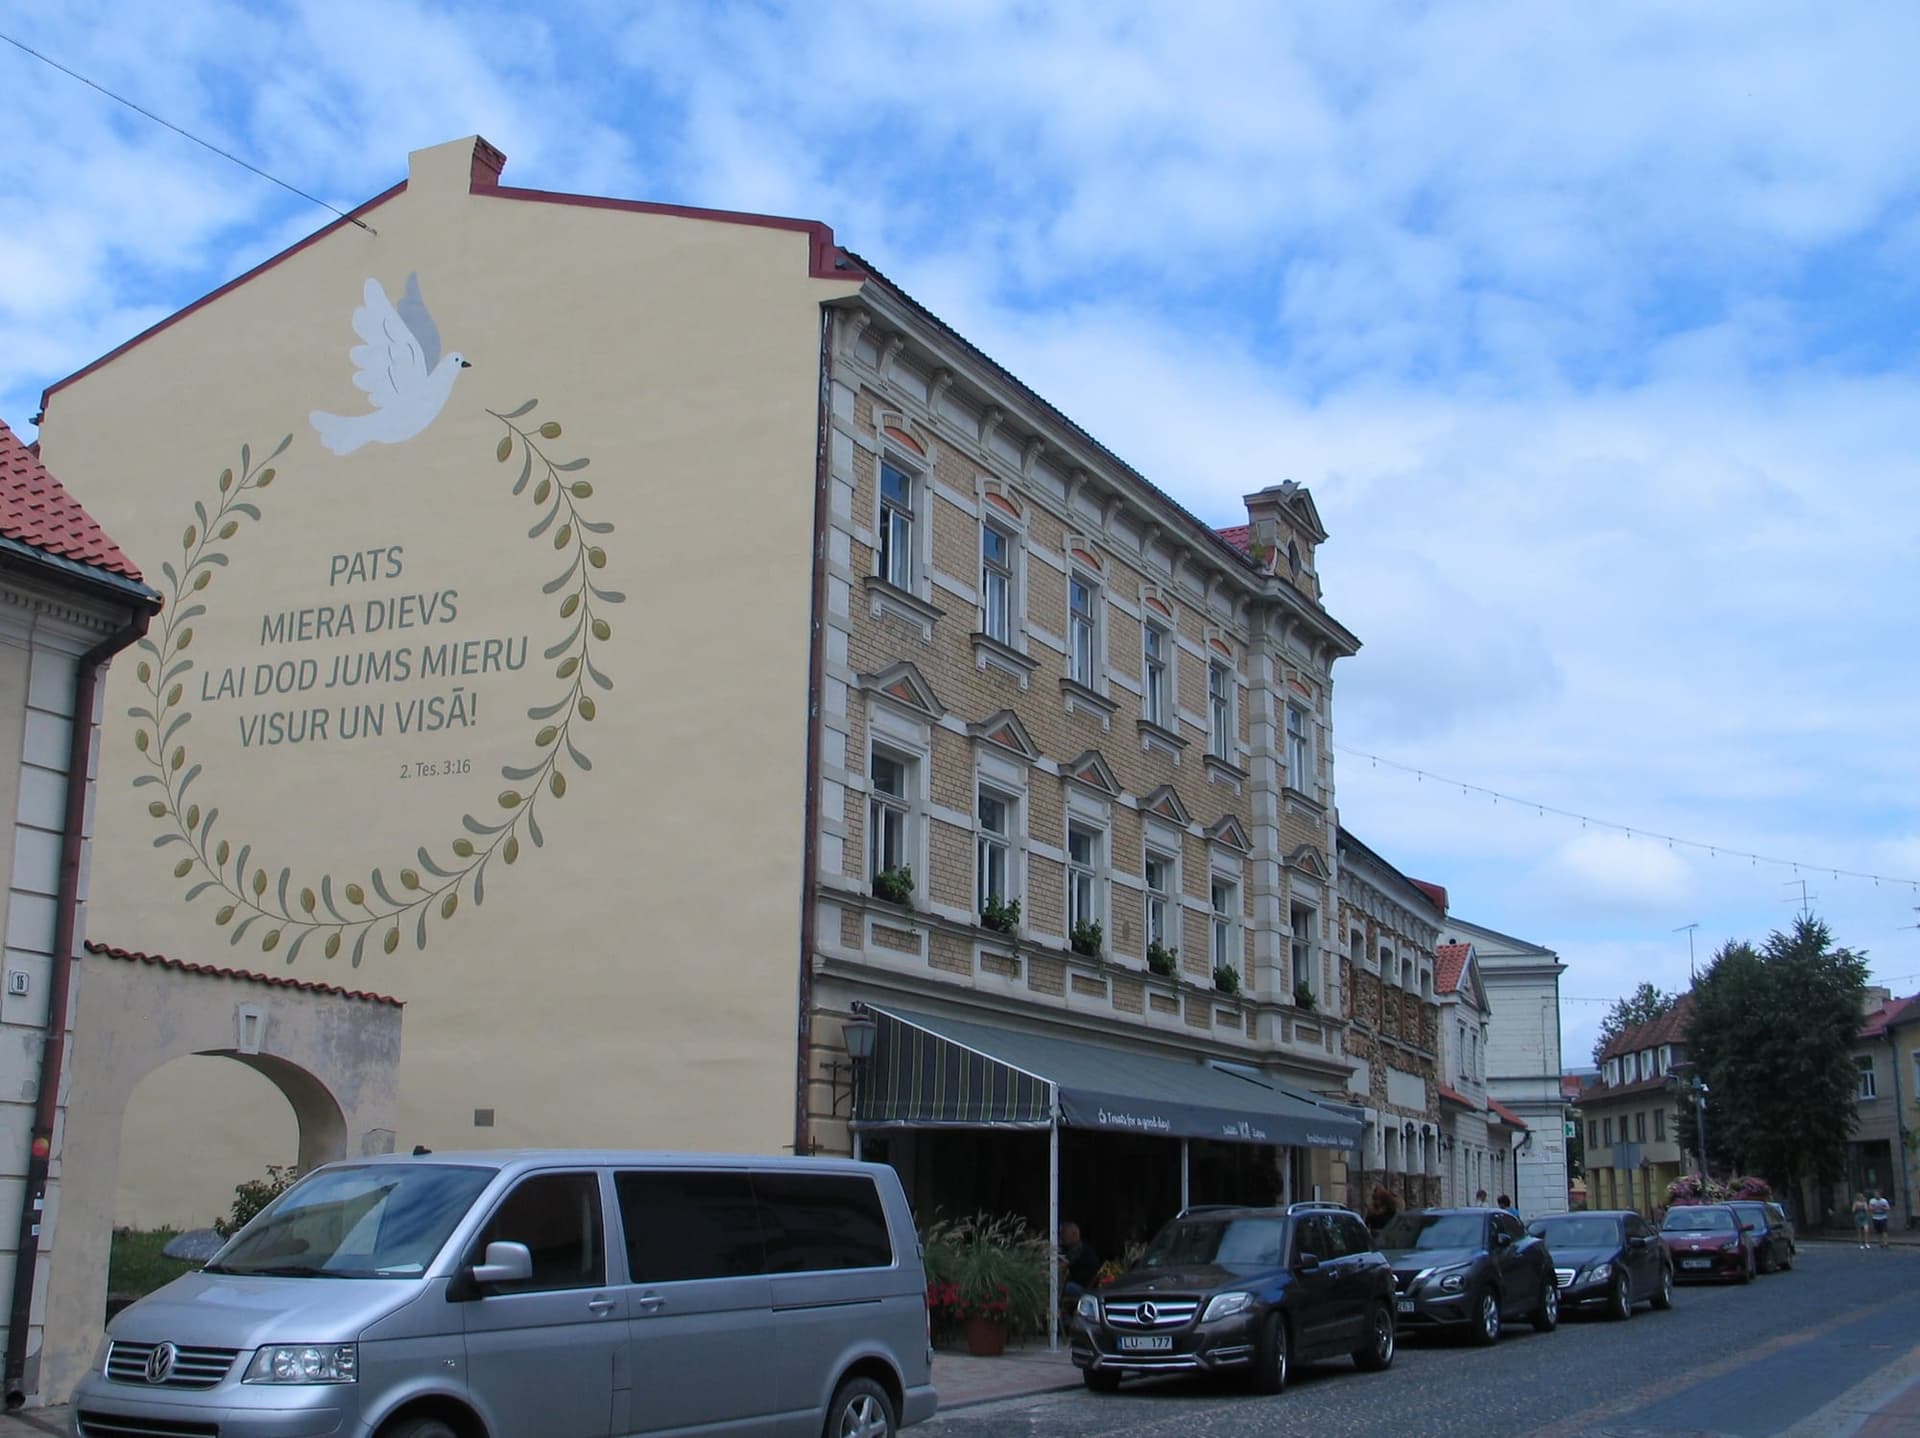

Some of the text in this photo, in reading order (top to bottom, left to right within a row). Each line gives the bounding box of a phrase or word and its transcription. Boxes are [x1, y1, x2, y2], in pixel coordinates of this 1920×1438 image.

[329, 545, 404, 586] PATS
[260, 590, 459, 646] MIERA DIEVS
[201, 636, 528, 701] LAI DOD JUMS MIERU
[239, 687, 477, 747] VISUR UN VISĀ!
[400, 760, 471, 779] 2. Tes. 3:16
[1152, 1337, 1170, 1348] 177
